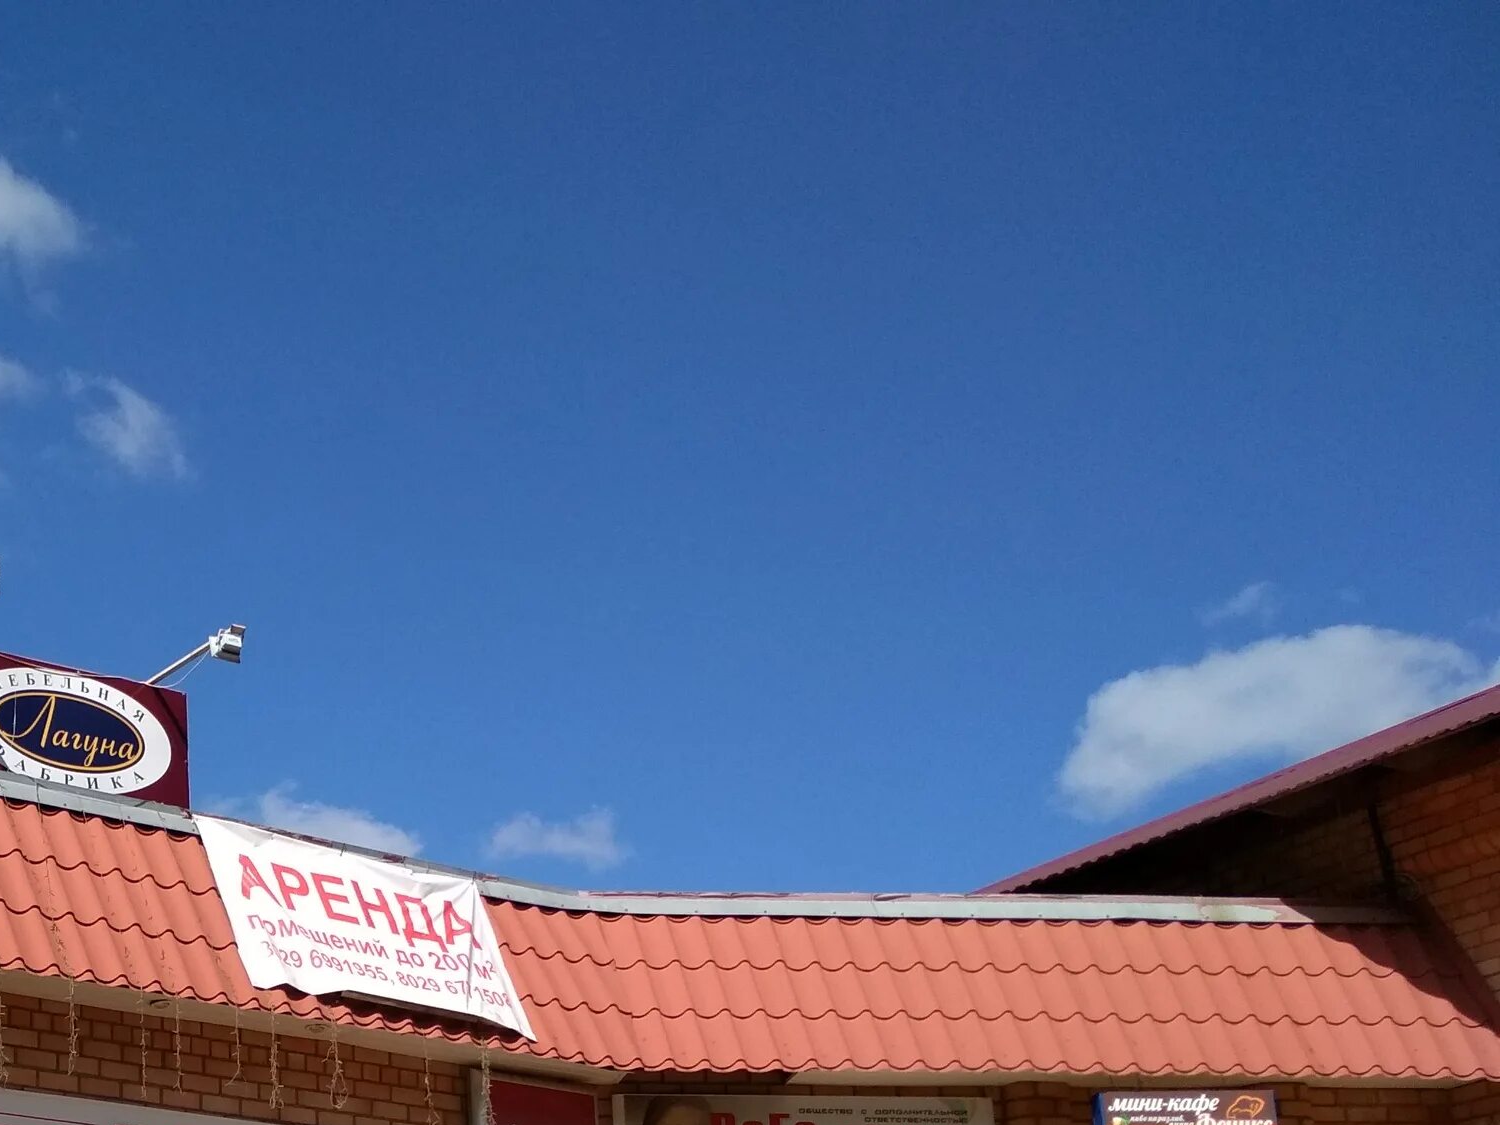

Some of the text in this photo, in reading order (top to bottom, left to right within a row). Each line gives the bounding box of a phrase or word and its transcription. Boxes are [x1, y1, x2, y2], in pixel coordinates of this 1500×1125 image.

[0, 695, 136, 767] Лагуна
[238, 853, 483, 952] АРЕНДА
[396, 949, 425, 968] до
[396, 971, 441, 992] 8029
[1108, 1093, 1220, 1115] мини-кафе
